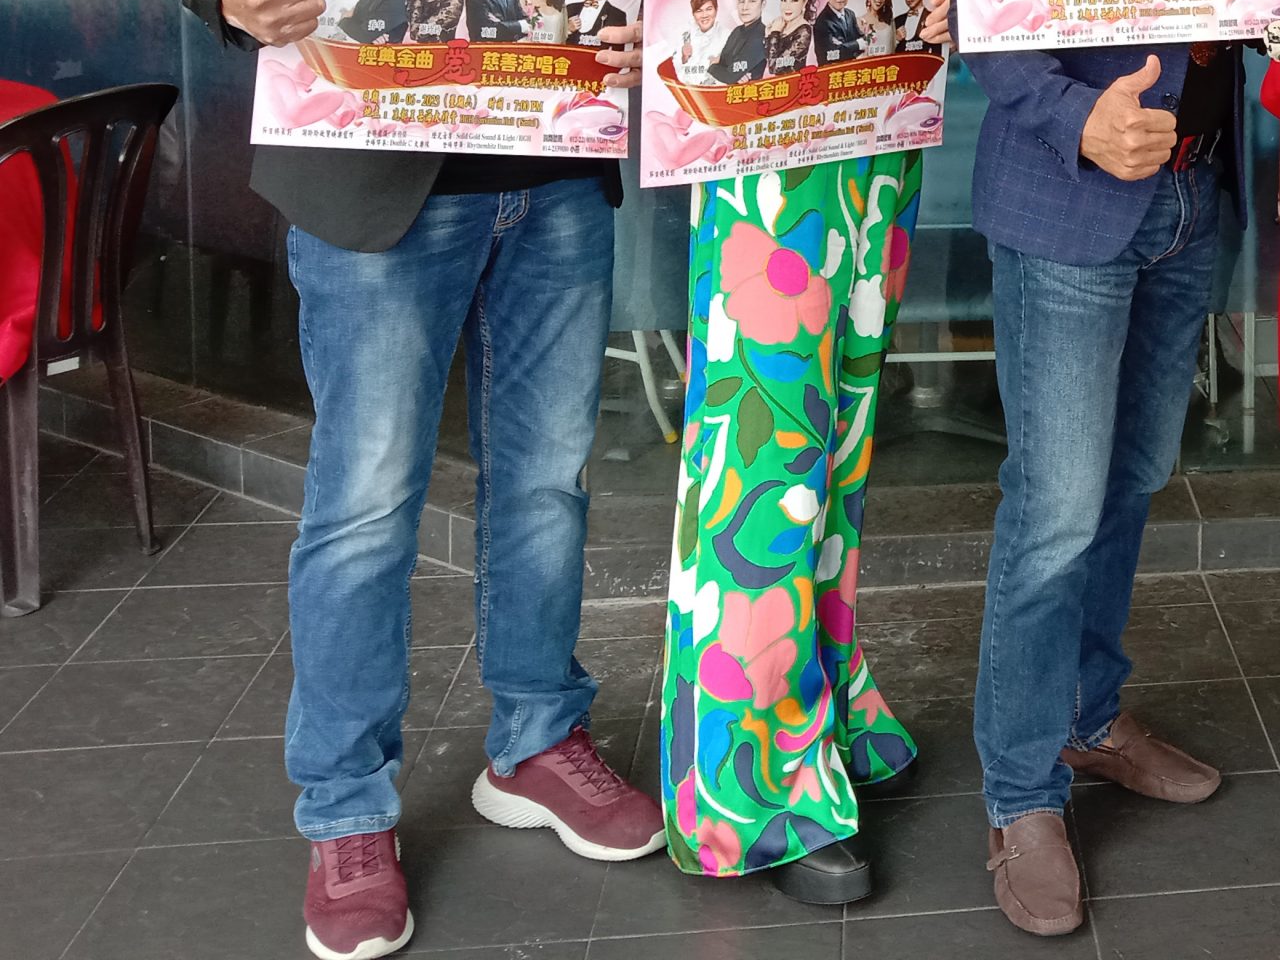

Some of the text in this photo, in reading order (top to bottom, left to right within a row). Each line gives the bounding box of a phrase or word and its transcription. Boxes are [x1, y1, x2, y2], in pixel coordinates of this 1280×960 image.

[358, 46, 435, 69] 經典金曲
[482, 51, 571, 76] 慈善演唱會
[726, 82, 790, 104] 經典金曲
[828, 65, 899, 89] 慈善演唱會
